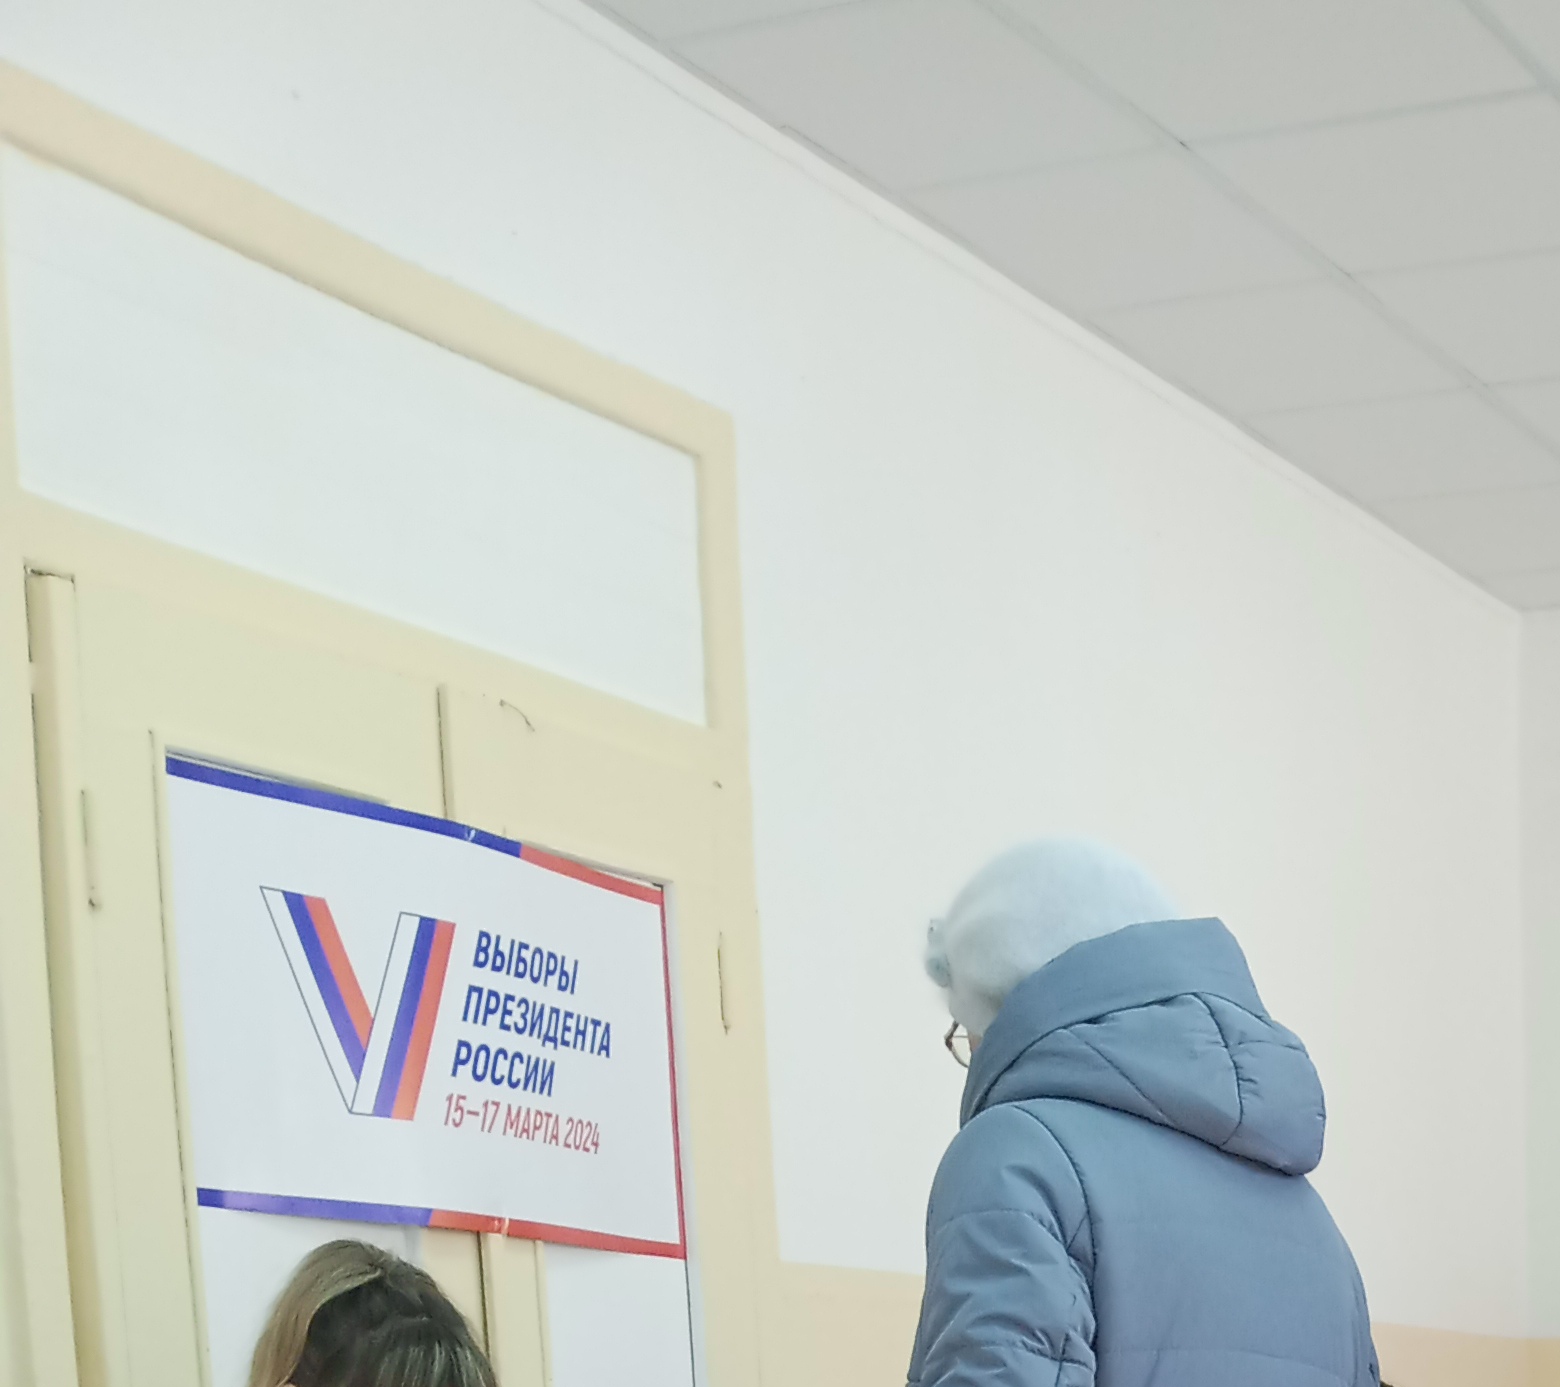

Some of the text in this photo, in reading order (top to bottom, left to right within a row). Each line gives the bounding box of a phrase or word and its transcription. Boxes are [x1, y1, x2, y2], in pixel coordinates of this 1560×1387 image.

[473, 930, 578, 995] ВЫБОРЫ
[462, 984, 611, 1058] ПРЕЗИДЕНТА
[451, 1039, 556, 1097] РОССИИ
[502, 1103, 560, 1147] МАРТА
[563, 1117, 600, 1155] 2024
